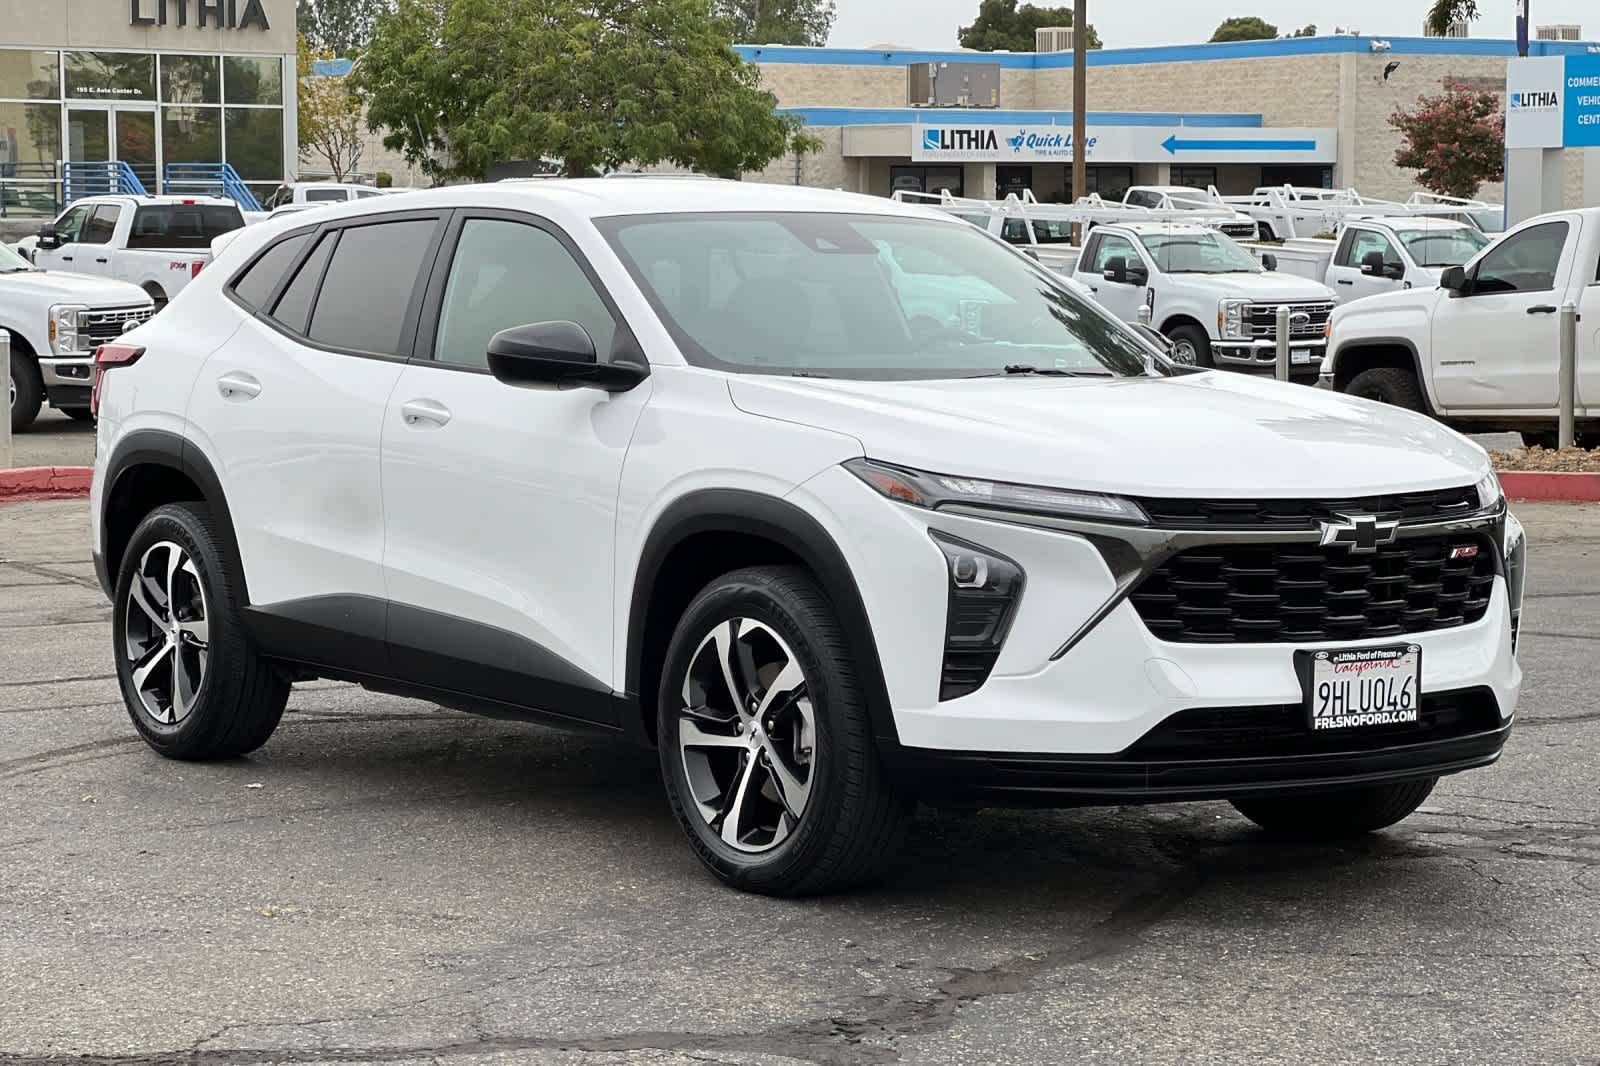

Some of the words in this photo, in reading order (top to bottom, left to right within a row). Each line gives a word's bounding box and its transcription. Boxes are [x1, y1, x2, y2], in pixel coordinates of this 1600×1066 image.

[128, 0, 271, 30] LITHIA
[1567, 76, 1600, 88] COMME
[1521, 91, 1558, 107] LITHIA
[940, 129, 999, 150] LITHIA
[1026, 132, 1063, 149] Quick
[1064, 133, 1098, 148] Le
[1339, 653, 1356, 661] Lithia
[1356, 652, 1370, 660] Ford
[1370, 651, 1377, 659] of
[1377, 650, 1397, 659] Fresno
[1334, 659, 1401, 677] California
[1318, 675, 1413, 717] 9HLU046
[1314, 709, 1417, 730] FRESNOFORD.COM
